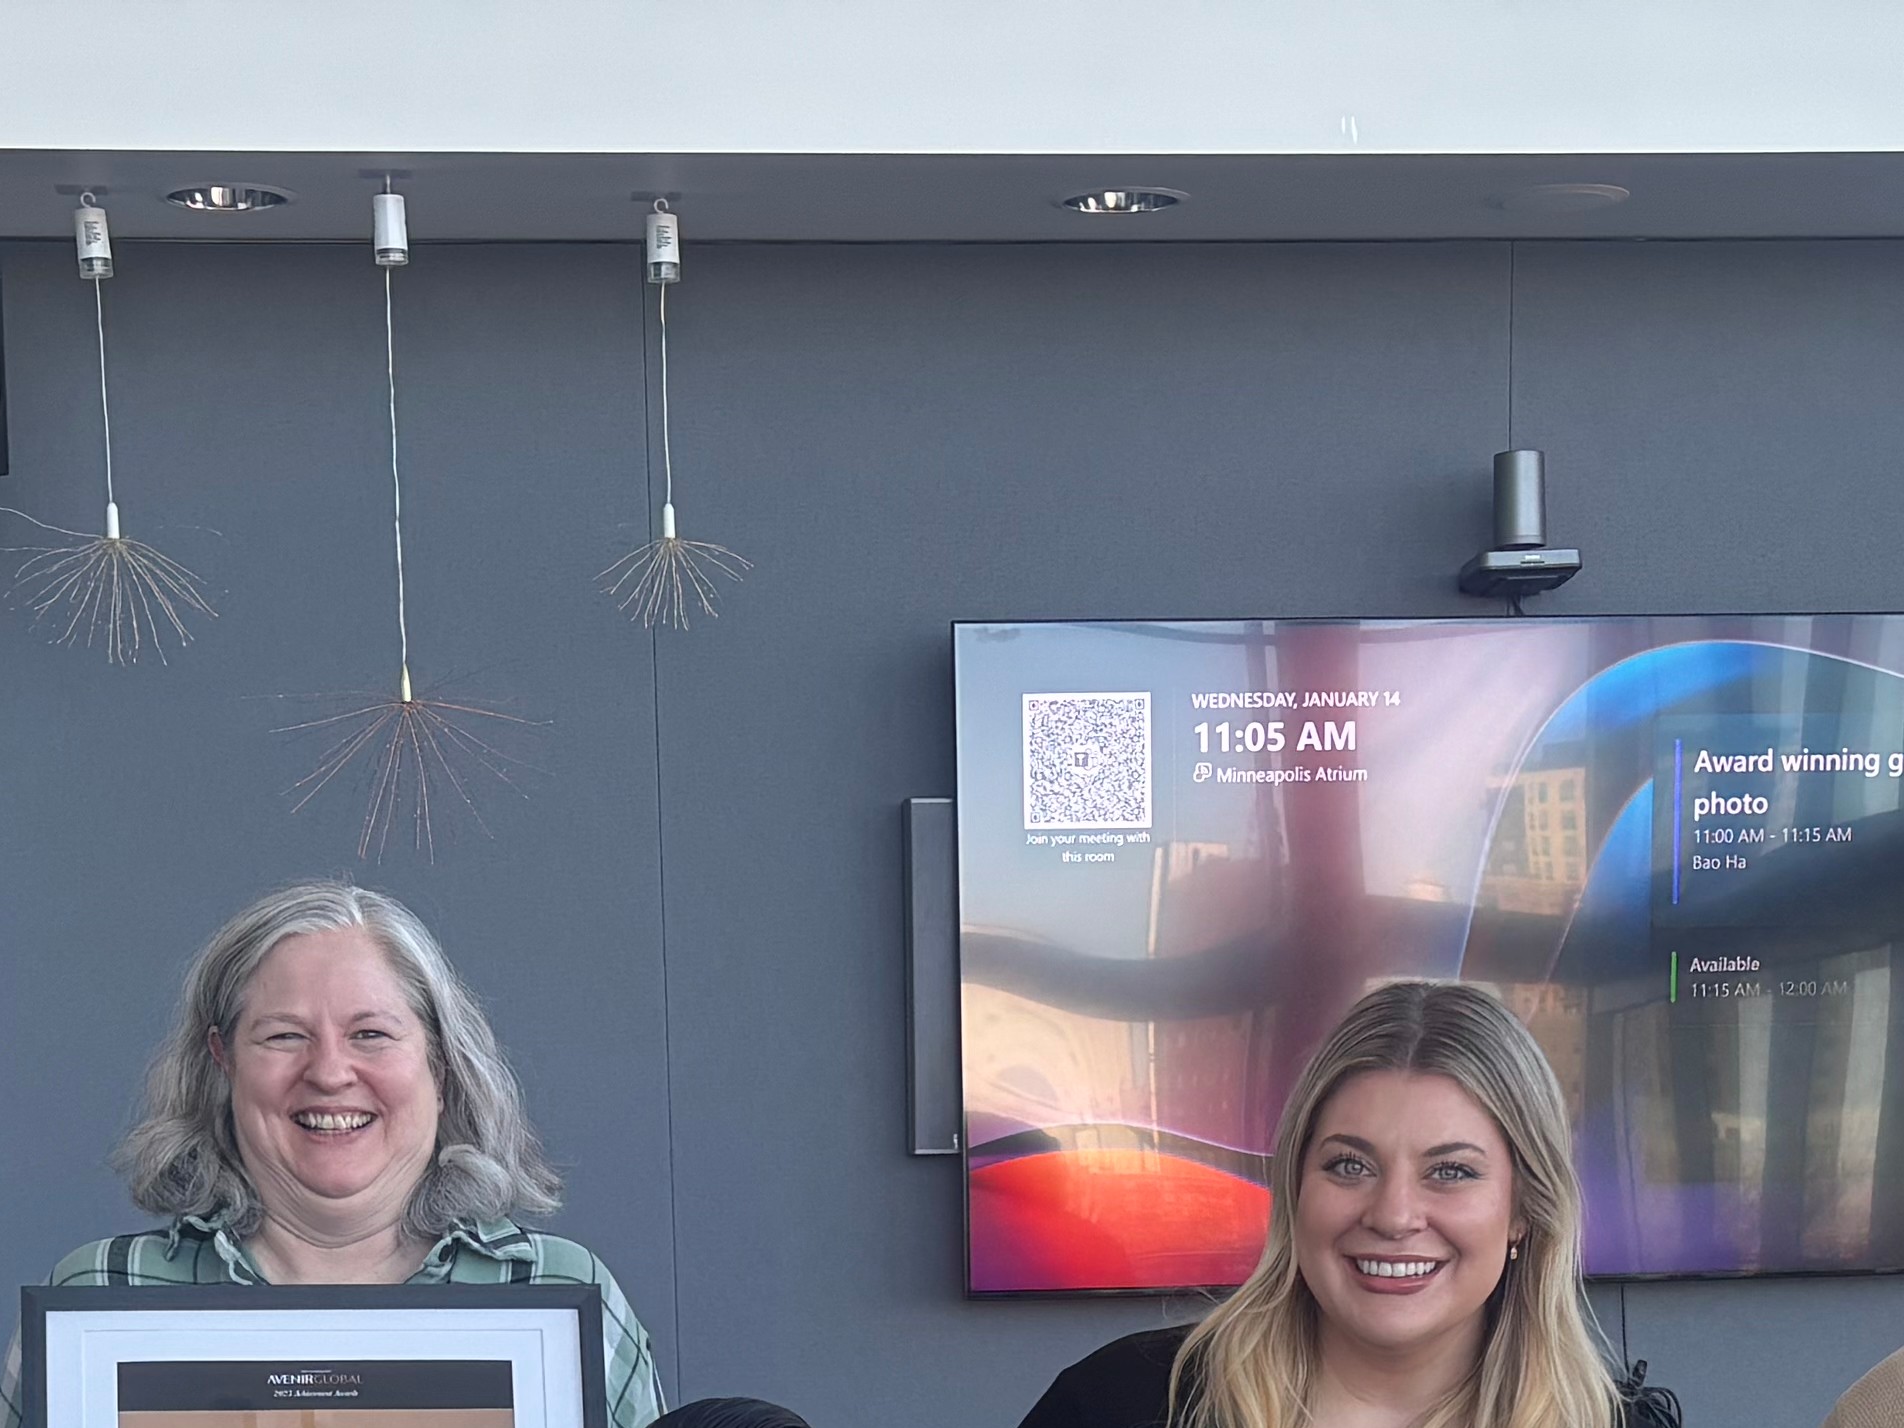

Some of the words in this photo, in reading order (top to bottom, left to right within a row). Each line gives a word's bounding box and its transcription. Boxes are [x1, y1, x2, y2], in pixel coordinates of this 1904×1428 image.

[1191, 691, 1298, 710] WEDNESDAY,
[1302, 690, 1379, 708] JANUARY
[1383, 691, 1400, 705] 14
[1194, 721, 1286, 753] 11:05
[1296, 720, 1356, 751] AM
[1694, 747, 1774, 773] Award
[1781, 747, 1881, 778] winning
[1216, 765, 1312, 787] Minneapolis
[1314, 764, 1368, 782] Atrium
[1694, 790, 1769, 822] photo
[1026, 832, 1049, 845] Join
[1050, 834, 1076, 847] your
[1078, 830, 1125, 847] meeting
[1124, 830, 1151, 843] with
[1694, 827, 1734, 844] 11:00
[1737, 827, 1765, 843] AM
[1782, 826, 1822, 842] 11:15
[1825, 826, 1852, 842] AM
[1061, 850, 1083, 863] this
[1084, 852, 1115, 862] room
[1692, 854, 1722, 870] Bao
[1725, 853, 1747, 869] Ha
[1689, 955, 1760, 973] Available
[1692, 982, 1730, 998] 11:15
[1734, 982, 1760, 996] AM
[1821, 980, 1847, 995] AM
